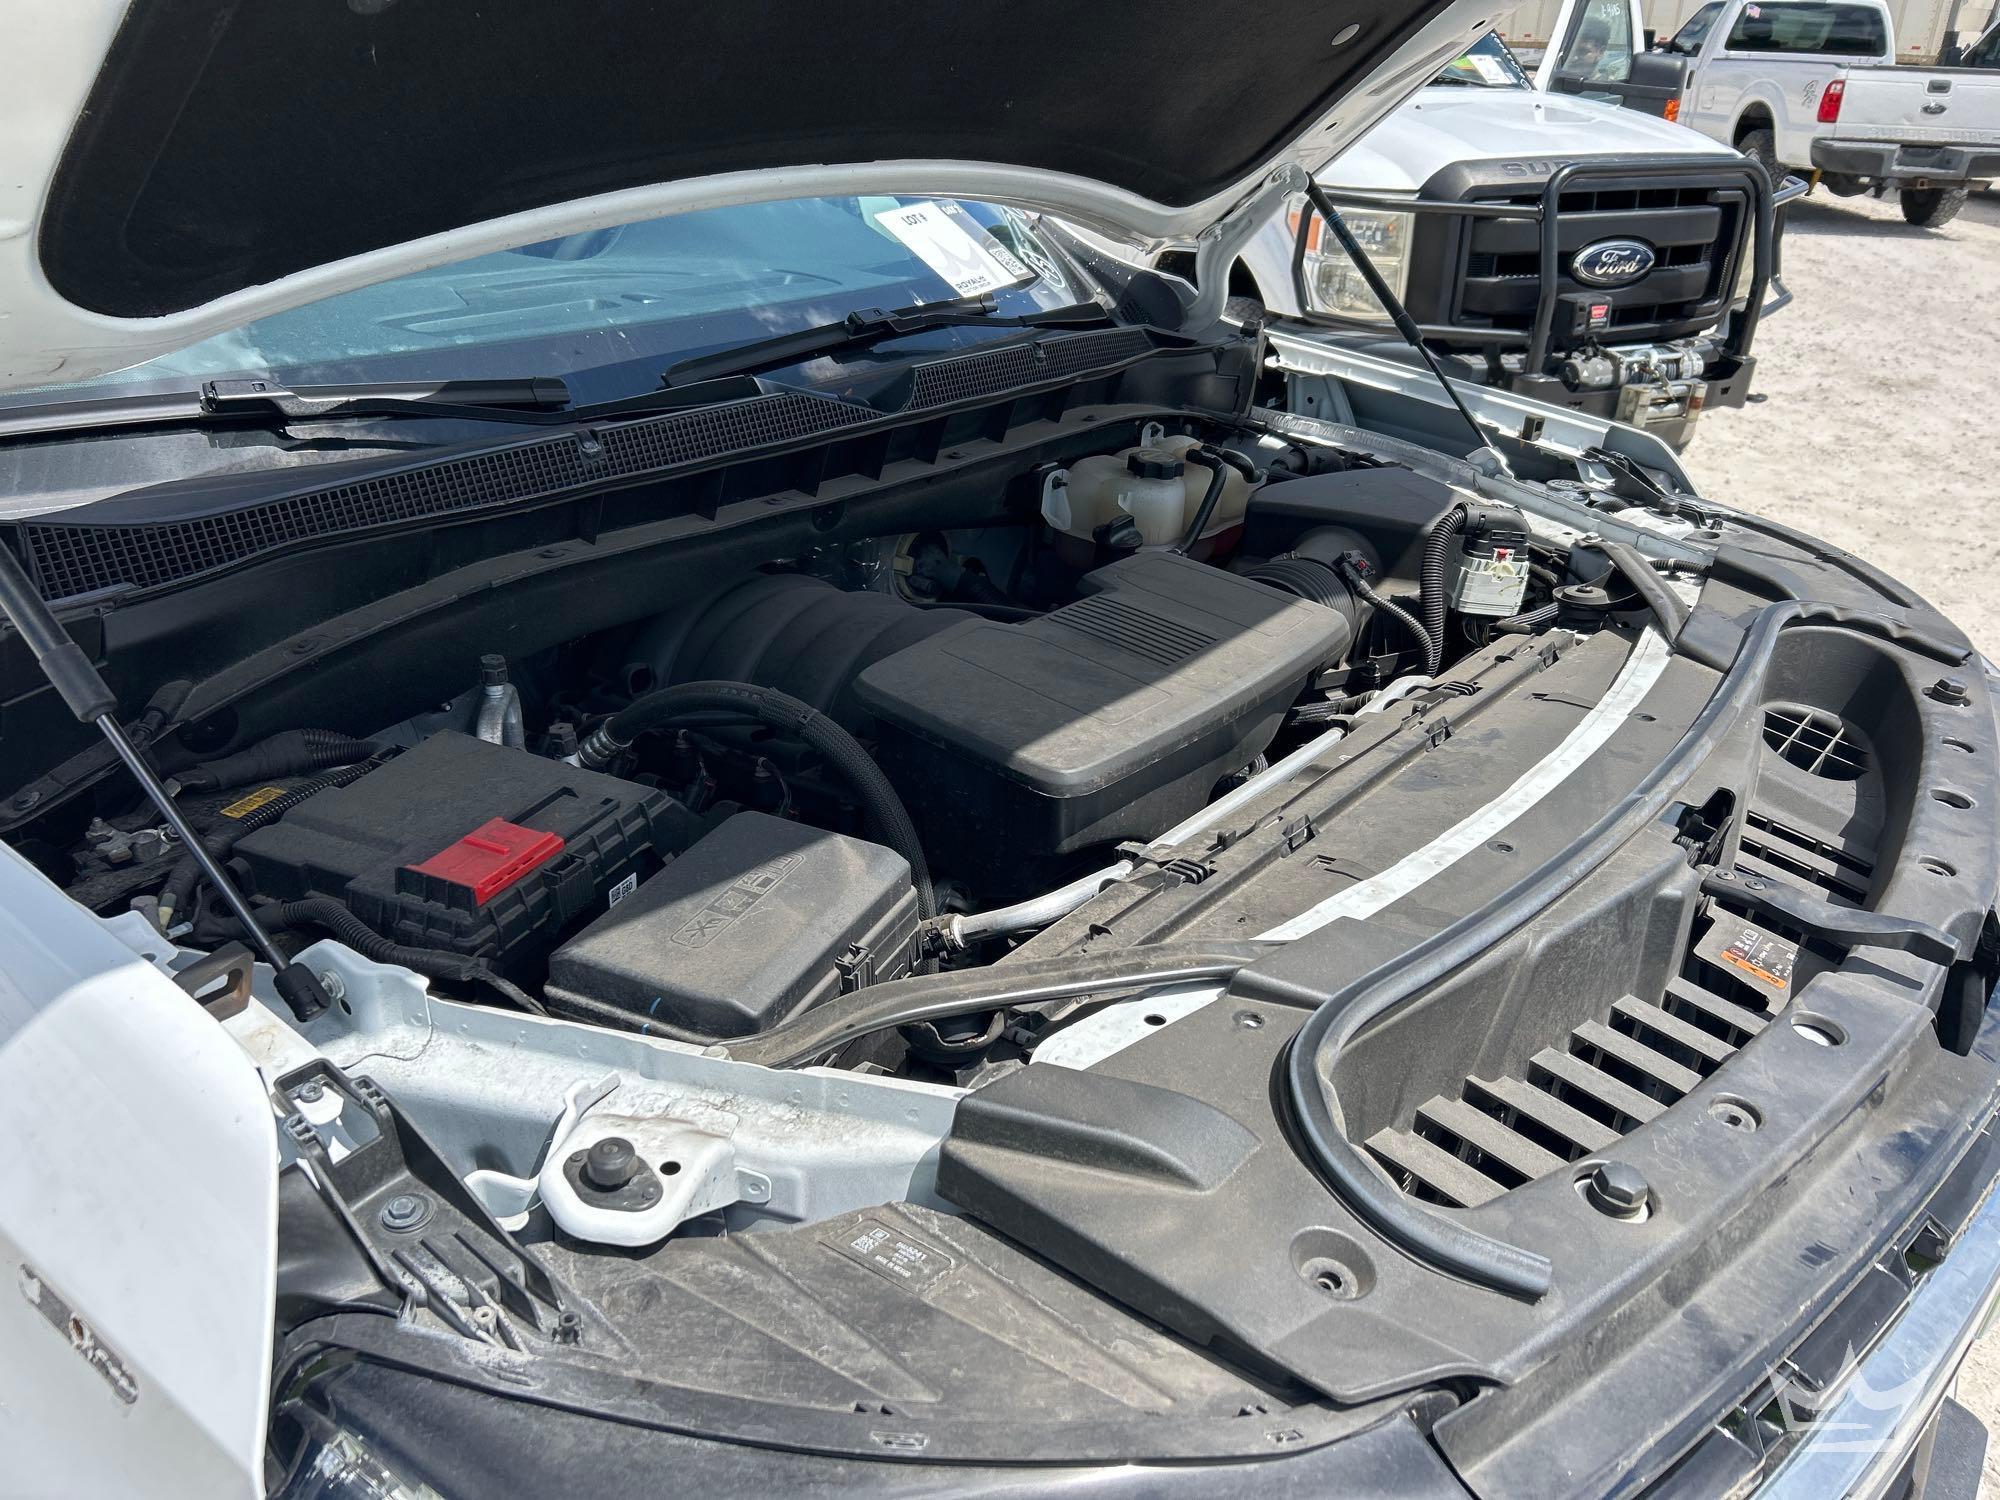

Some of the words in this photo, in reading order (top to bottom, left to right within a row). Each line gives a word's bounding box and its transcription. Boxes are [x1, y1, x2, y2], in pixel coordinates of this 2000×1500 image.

[901, 213, 921, 225] LOT
[1594, 249, 1640, 274] Ford
[955, 277, 979, 289] ROYAL
